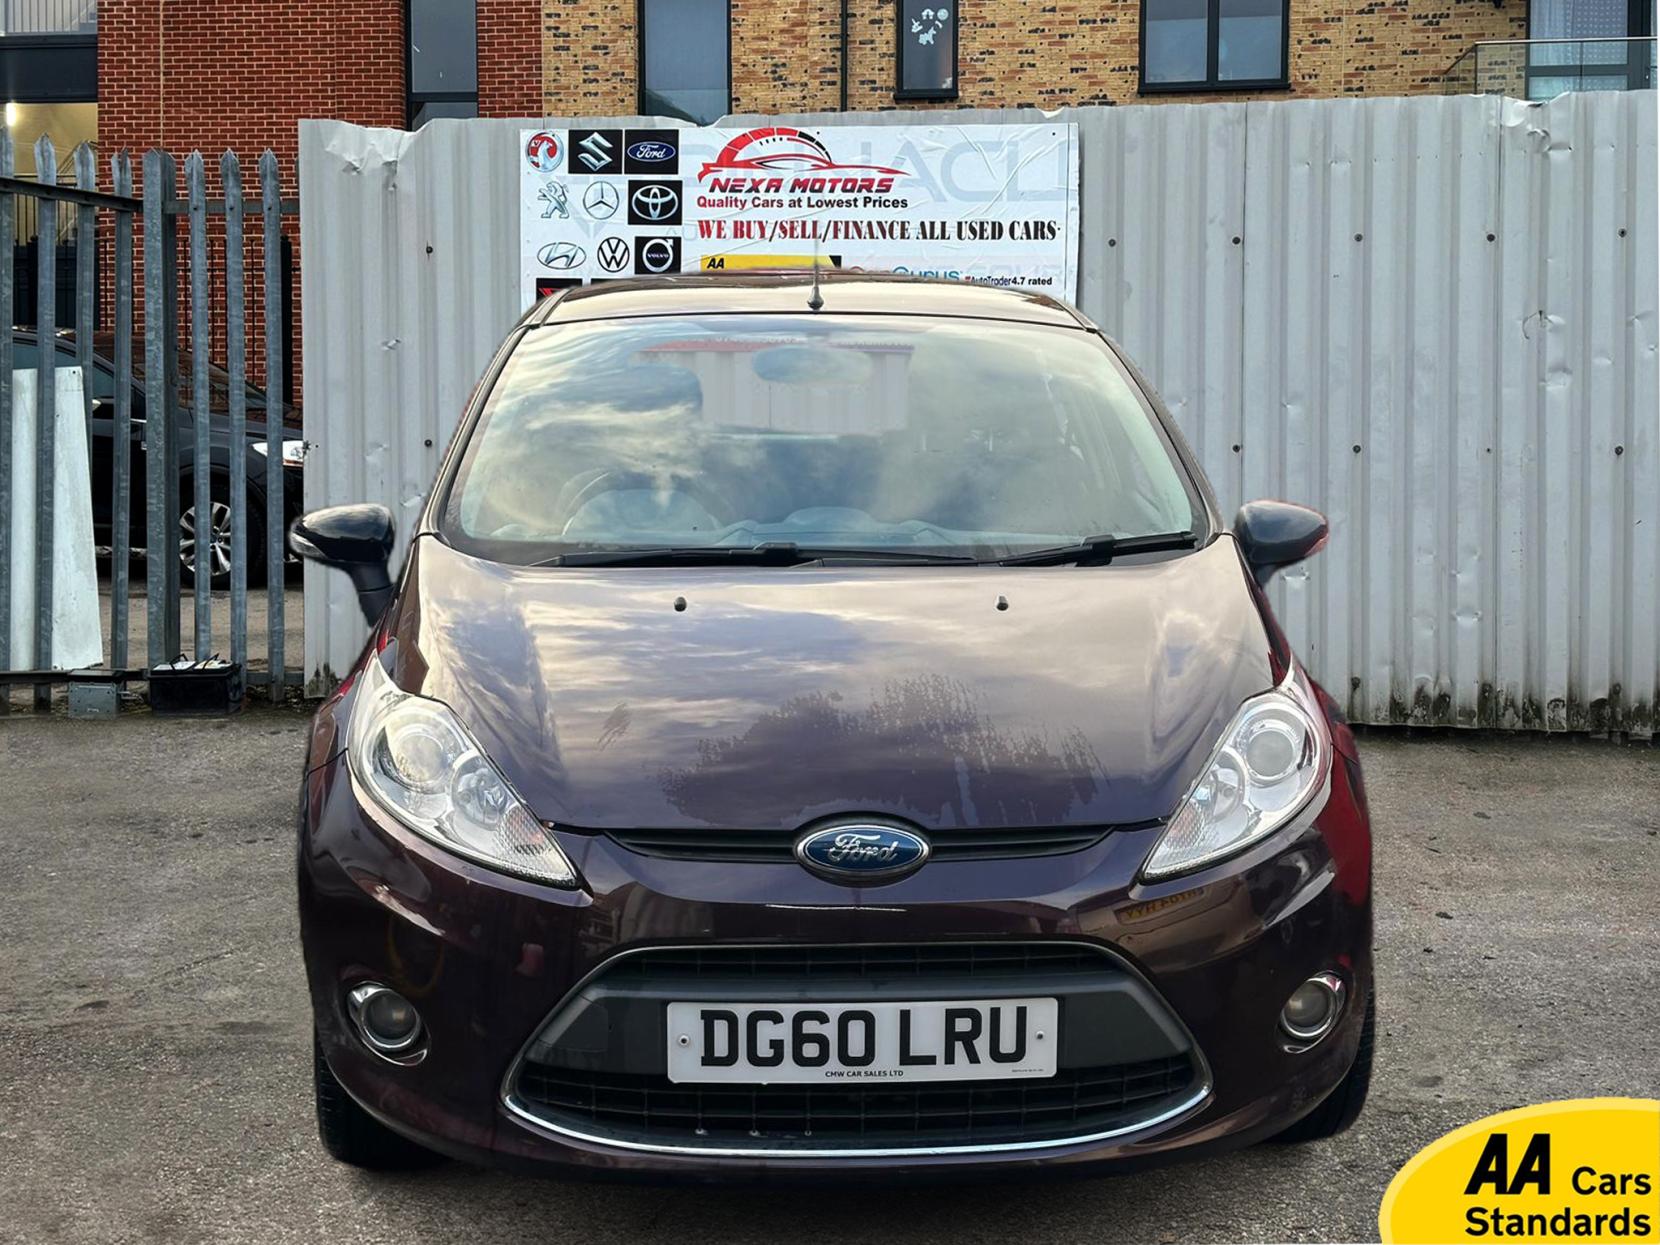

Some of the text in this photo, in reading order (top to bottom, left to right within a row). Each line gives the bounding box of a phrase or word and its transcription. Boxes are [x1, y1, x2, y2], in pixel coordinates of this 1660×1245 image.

[636, 144, 667, 159] Ford
[709, 177, 895, 194] NEXA MOTORS
[697, 196, 908, 210] Quality Cars at Lowest Prices
[696, 220, 727, 240] WE
[916, 221, 951, 241] ALL
[957, 221, 1004, 241] USED
[707, 258, 725, 269] AA
[1028, 277, 1053, 286] rated
[827, 833, 899, 862] Ford
[700, 1006, 1028, 1068] DG60 LRU
[825, 1069, 904, 1078] CMW CAR SALES LTD
